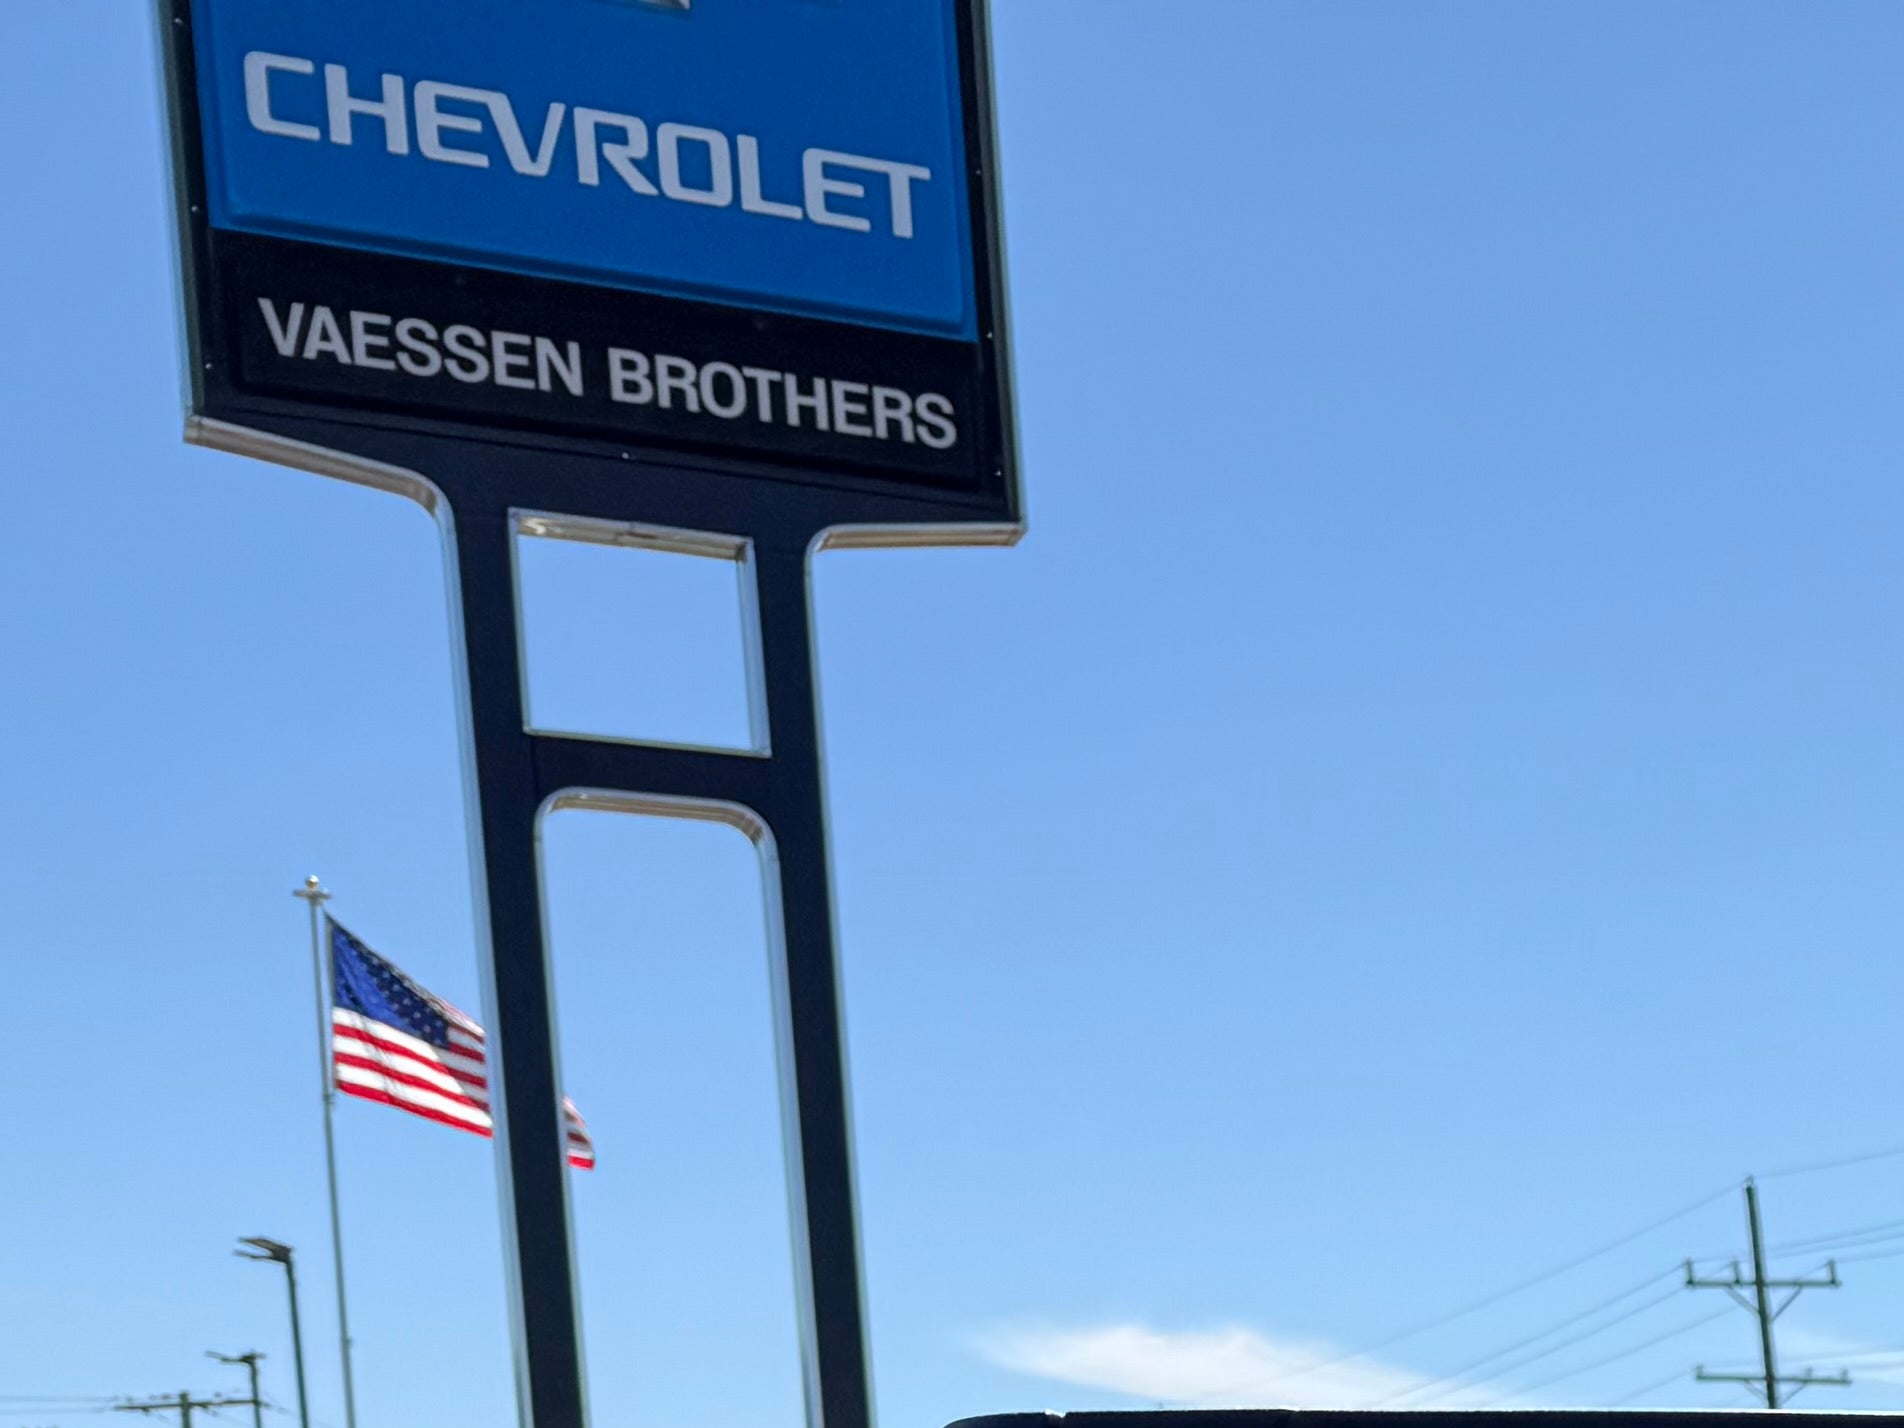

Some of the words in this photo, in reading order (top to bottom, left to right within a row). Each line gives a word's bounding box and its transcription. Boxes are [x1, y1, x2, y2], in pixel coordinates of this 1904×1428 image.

[243, 50, 932, 239] CHEVROLET
[257, 296, 584, 396] VAESSEN
[609, 346, 957, 449] BROTHERS
